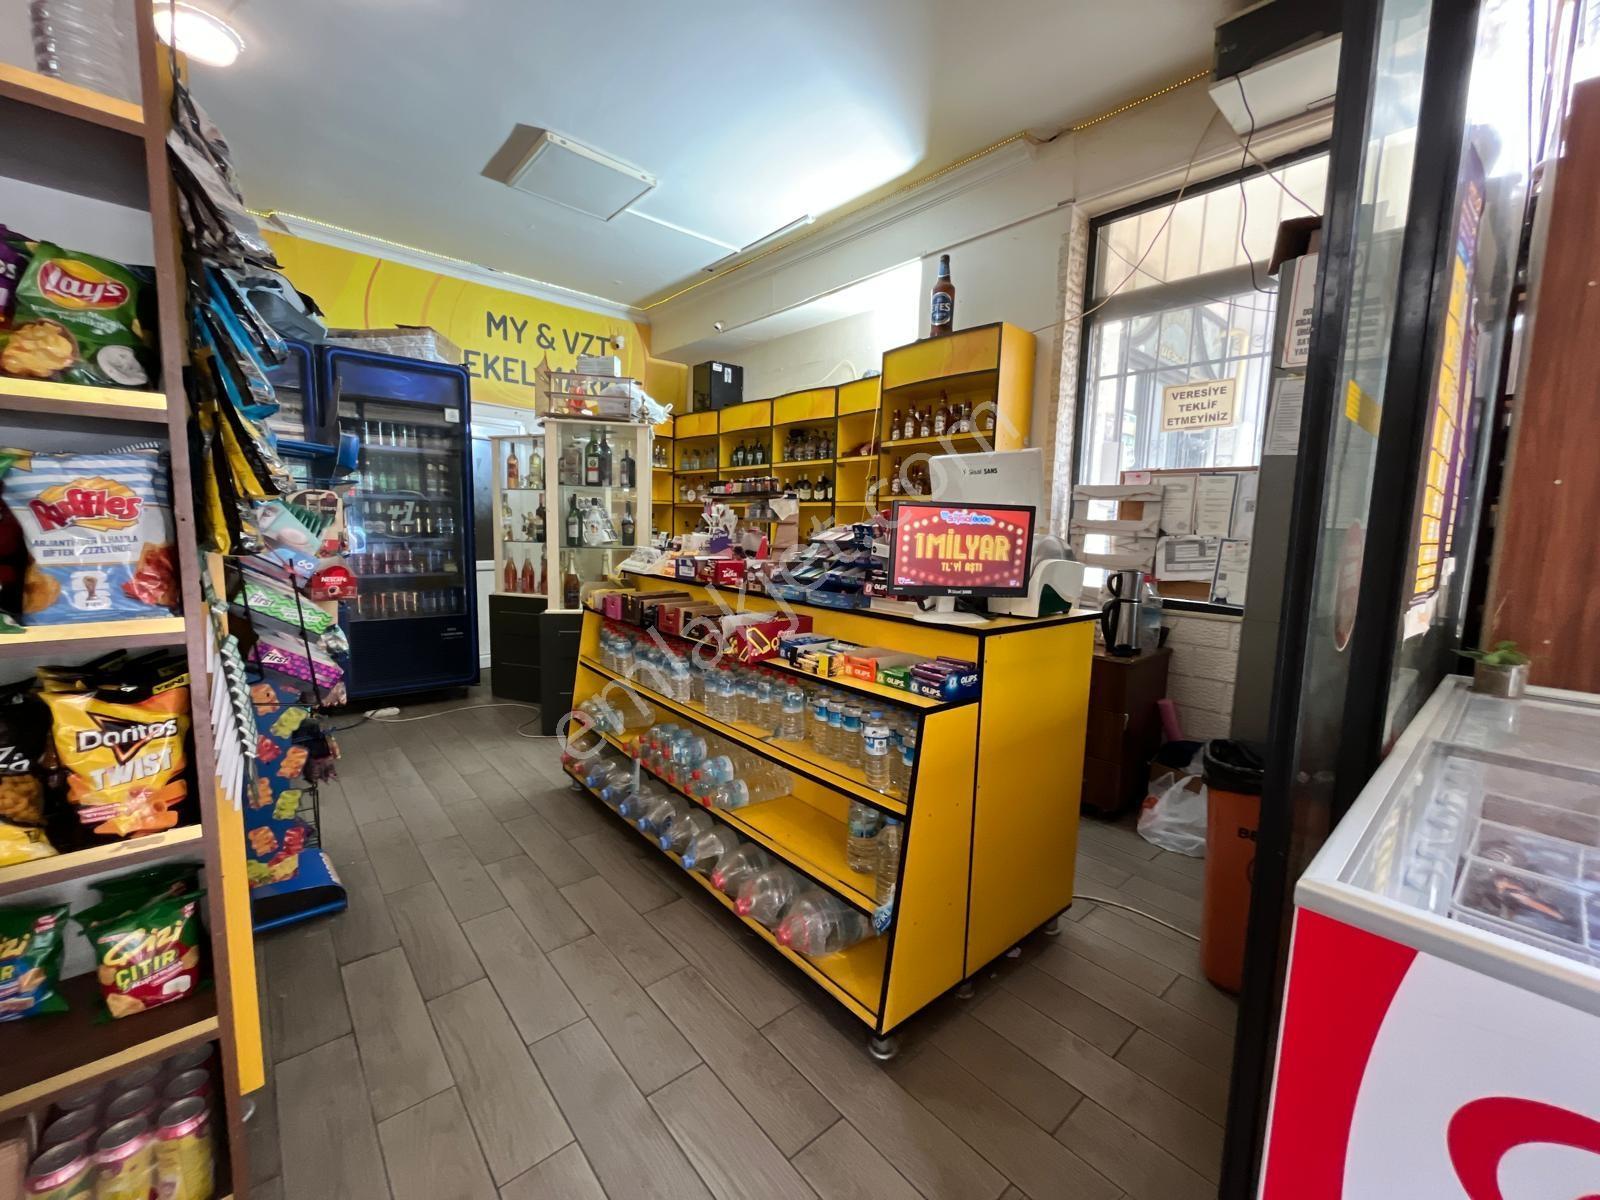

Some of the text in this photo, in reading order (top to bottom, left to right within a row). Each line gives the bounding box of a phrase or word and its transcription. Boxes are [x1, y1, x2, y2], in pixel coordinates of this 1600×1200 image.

[45, 265, 123, 303] Lay's
[486, 310, 612, 357] MY & VZT
[463, 349, 536, 388] EKEL
[1172, 387, 1227, 400] VERESİYE
[1178, 401, 1217, 413] TEKLİF
[1167, 413, 1228, 426] ETMEYİNİZ
[28, 488, 143, 532] Ruffles
[914, 528, 1011, 562] 1 MİLYAR
[249, 592, 275, 607] First
[264, 651, 290, 664] First
[886, 677, 905, 688] OLIPS
[961, 674, 978, 685] OLIPS
[921, 685, 942, 698] OLIPS
[77, 718, 178, 751] Doritos
[90, 747, 173, 791] TWIST
